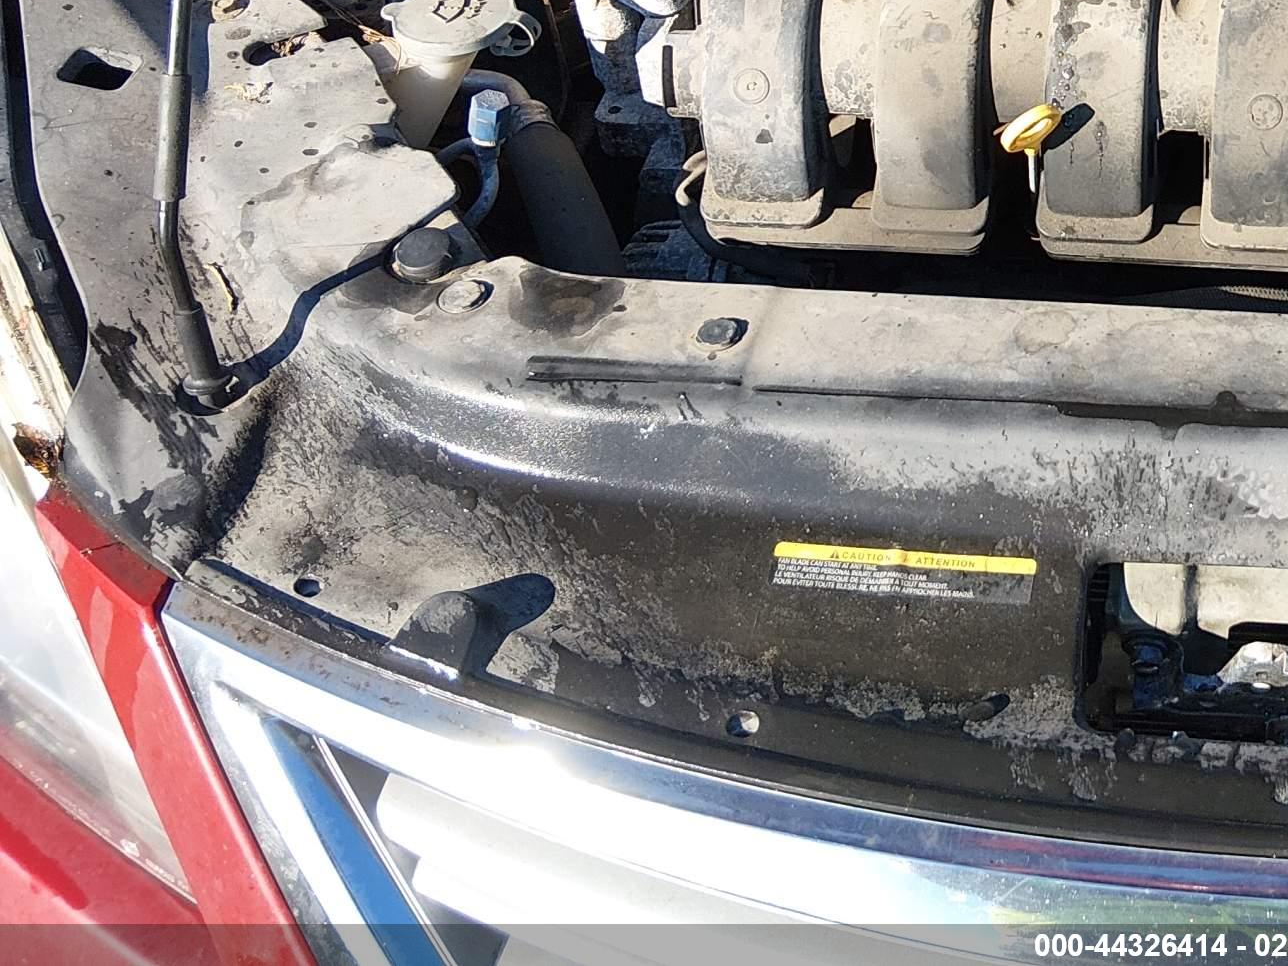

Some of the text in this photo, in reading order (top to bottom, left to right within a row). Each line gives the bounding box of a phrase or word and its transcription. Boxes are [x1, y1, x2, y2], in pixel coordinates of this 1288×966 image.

[791, 558, 809, 566] BLADE
[824, 560, 841, 568] START
[842, 552, 892, 563] CAUTION
[916, 556, 976, 568] ATTENTION
[784, 572, 825, 580] VENTILATEUR
[826, 574, 848, 583] RISQUE
[887, 571, 907, 579] HANDS
[773, 577, 792, 585] POUR
[814, 580, 835, 588] TOUTE
[902, 586, 939, 596] APPROCHER
